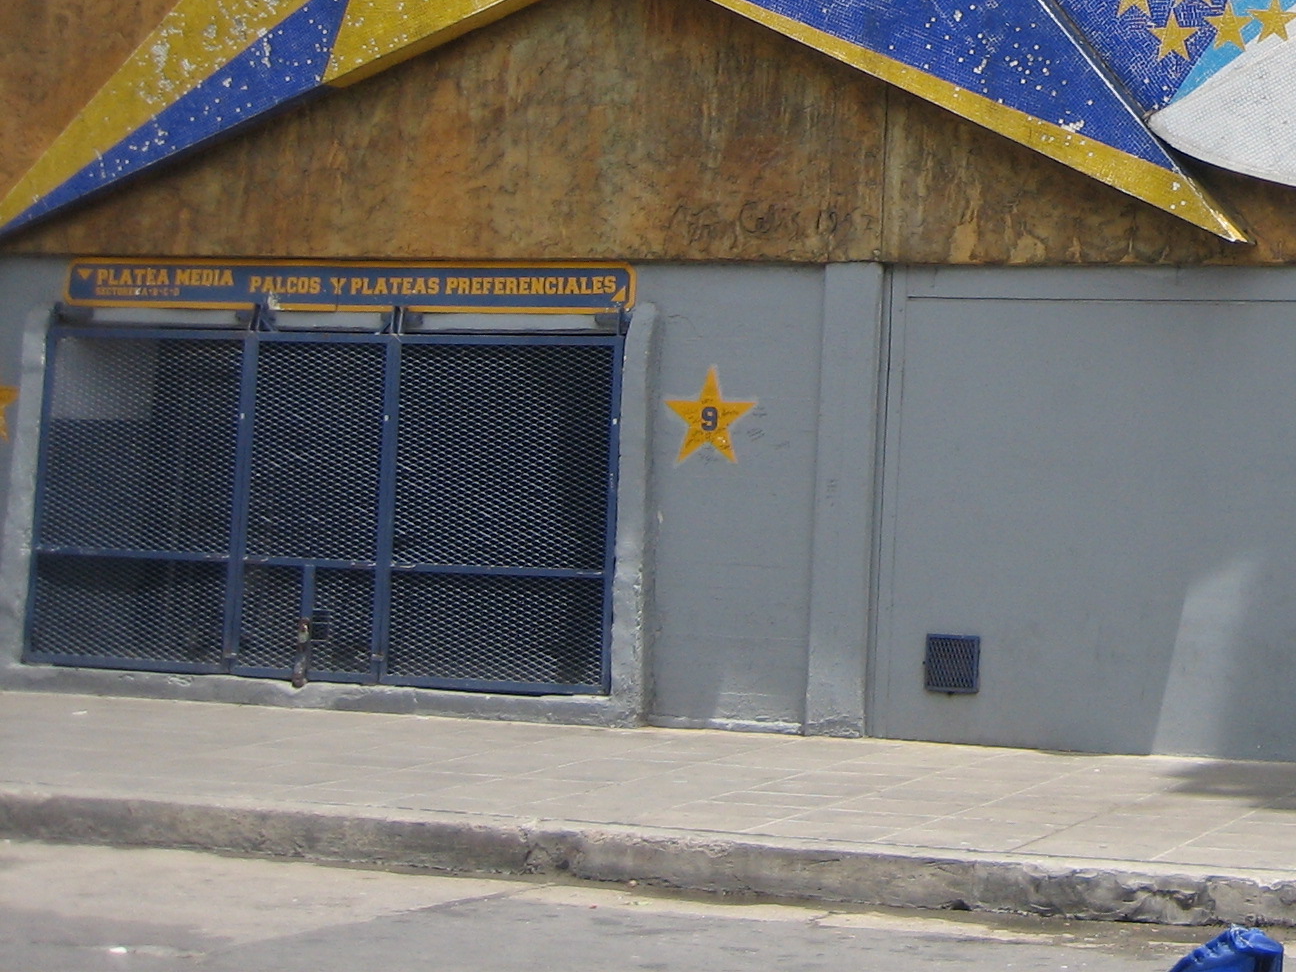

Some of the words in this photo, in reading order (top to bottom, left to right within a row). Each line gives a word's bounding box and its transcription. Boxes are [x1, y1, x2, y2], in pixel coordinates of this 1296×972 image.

[97, 268, 170, 286] PLATEA
[175, 269, 235, 286] MEDIA
[249, 275, 322, 294] PALCOS
[329, 277, 347, 295] Y
[351, 277, 440, 295] PLATEAS
[445, 275, 617, 295] PREFERENCIALES
[701, 406, 718, 432] 9
